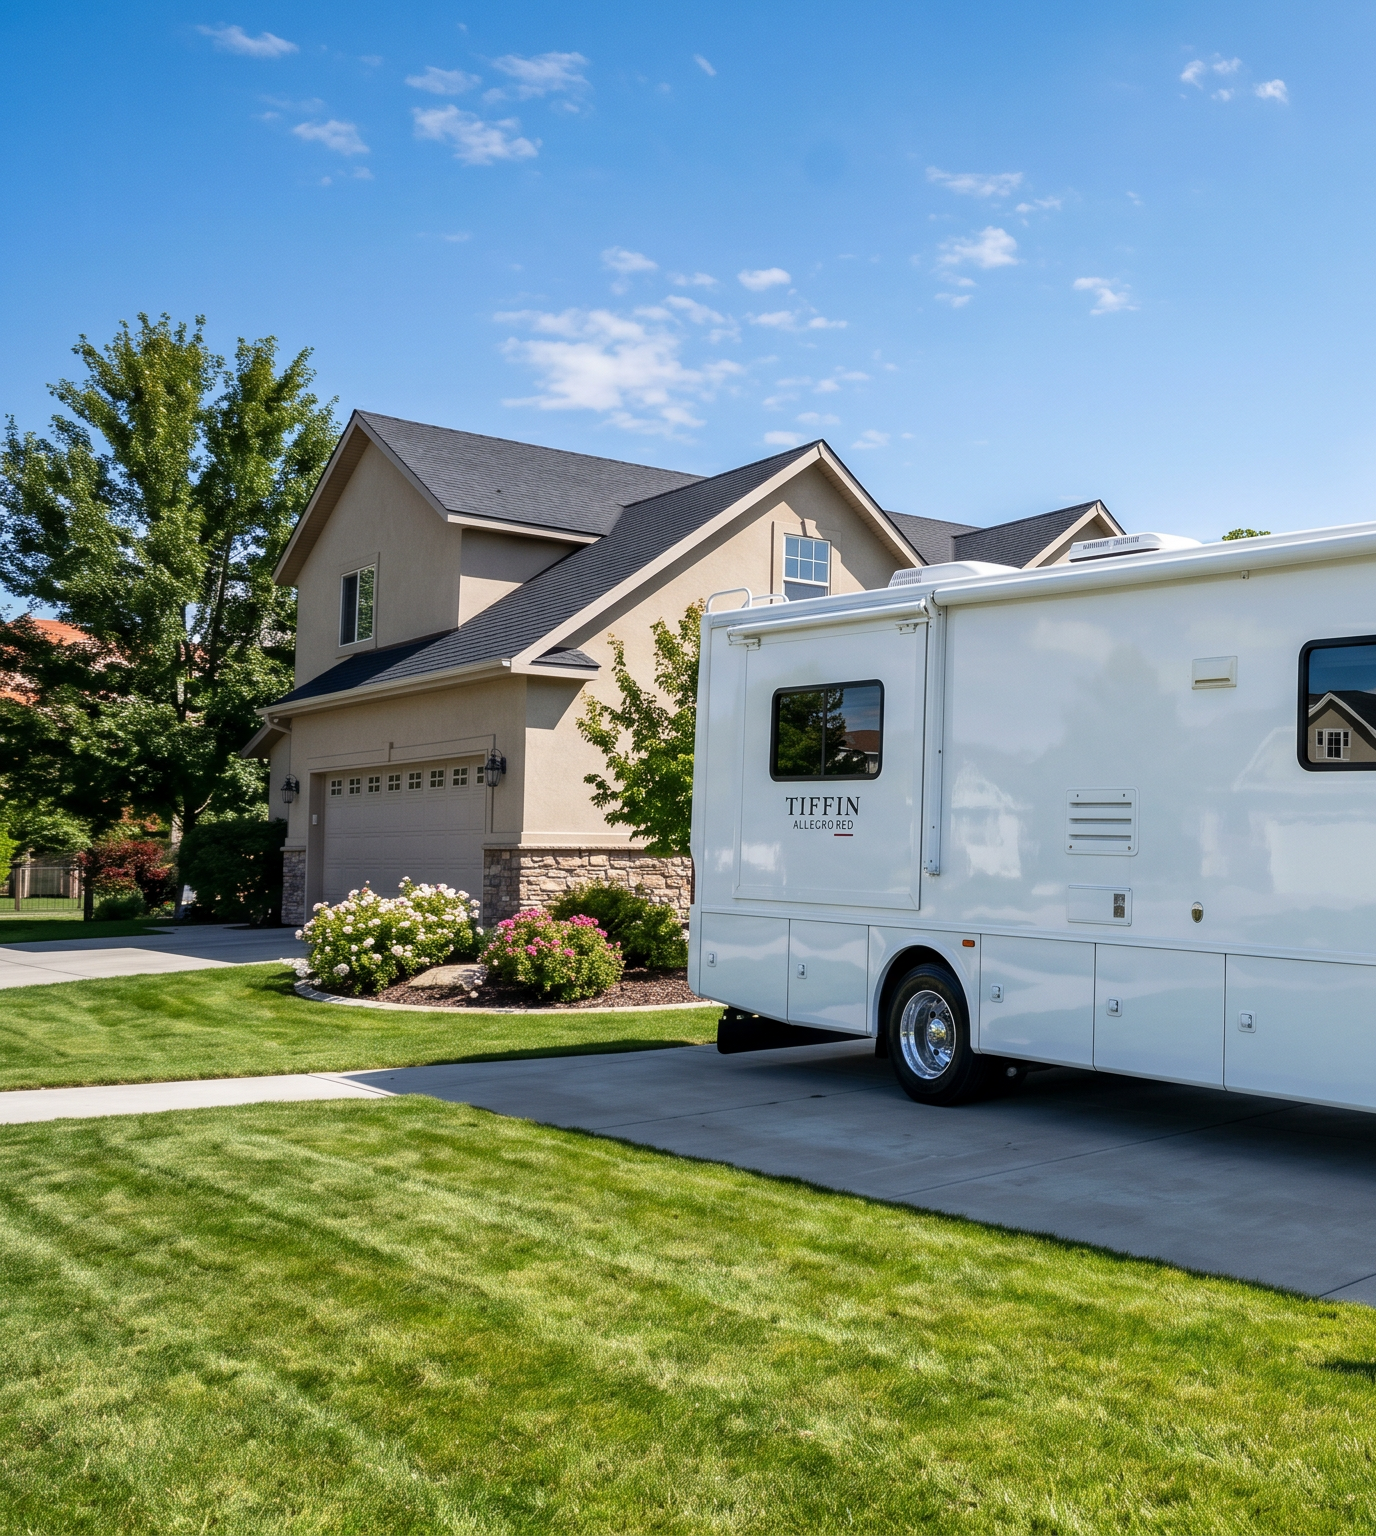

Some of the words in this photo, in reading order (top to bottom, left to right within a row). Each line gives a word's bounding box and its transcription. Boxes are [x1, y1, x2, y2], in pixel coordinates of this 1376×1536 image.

[785, 796, 861, 816] TIFFIN
[792, 819, 834, 830] ALLEGRO
[835, 819, 854, 830] RED
